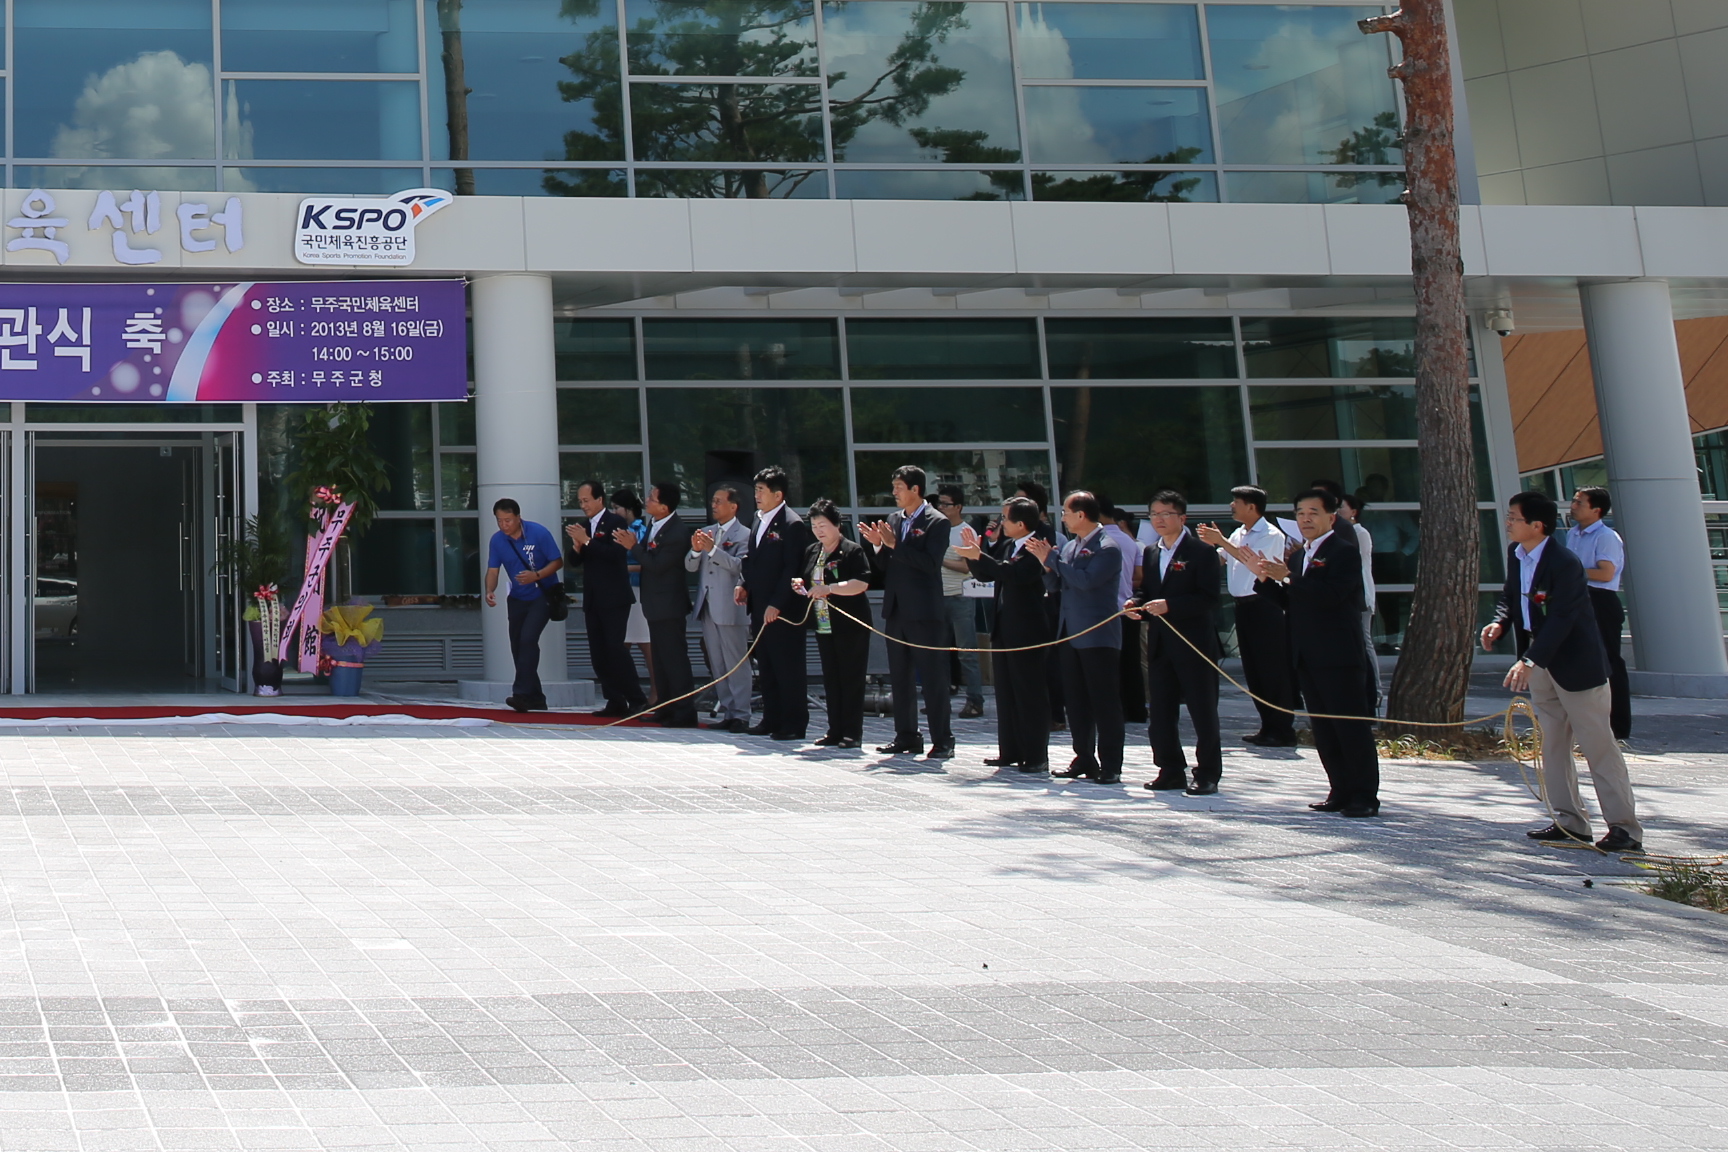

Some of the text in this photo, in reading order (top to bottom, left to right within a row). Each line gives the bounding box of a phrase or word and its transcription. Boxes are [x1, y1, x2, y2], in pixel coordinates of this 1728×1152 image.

[301, 204, 407, 232] KSPO
[301, 234, 408, 251] 국민체육진흥공단
[266, 297, 295, 313] 장소
[310, 296, 419, 313] 무주국민체육센터
[121, 312, 167, 354] 축
[266, 321, 294, 337] 일시
[311, 321, 358, 337] 2013년
[362, 320, 385, 337] 8월
[391, 319, 444, 338] 16일(금)
[312, 346, 352, 361] 14:00
[374, 346, 413, 361] 15:00
[266, 370, 295, 387] 주최
